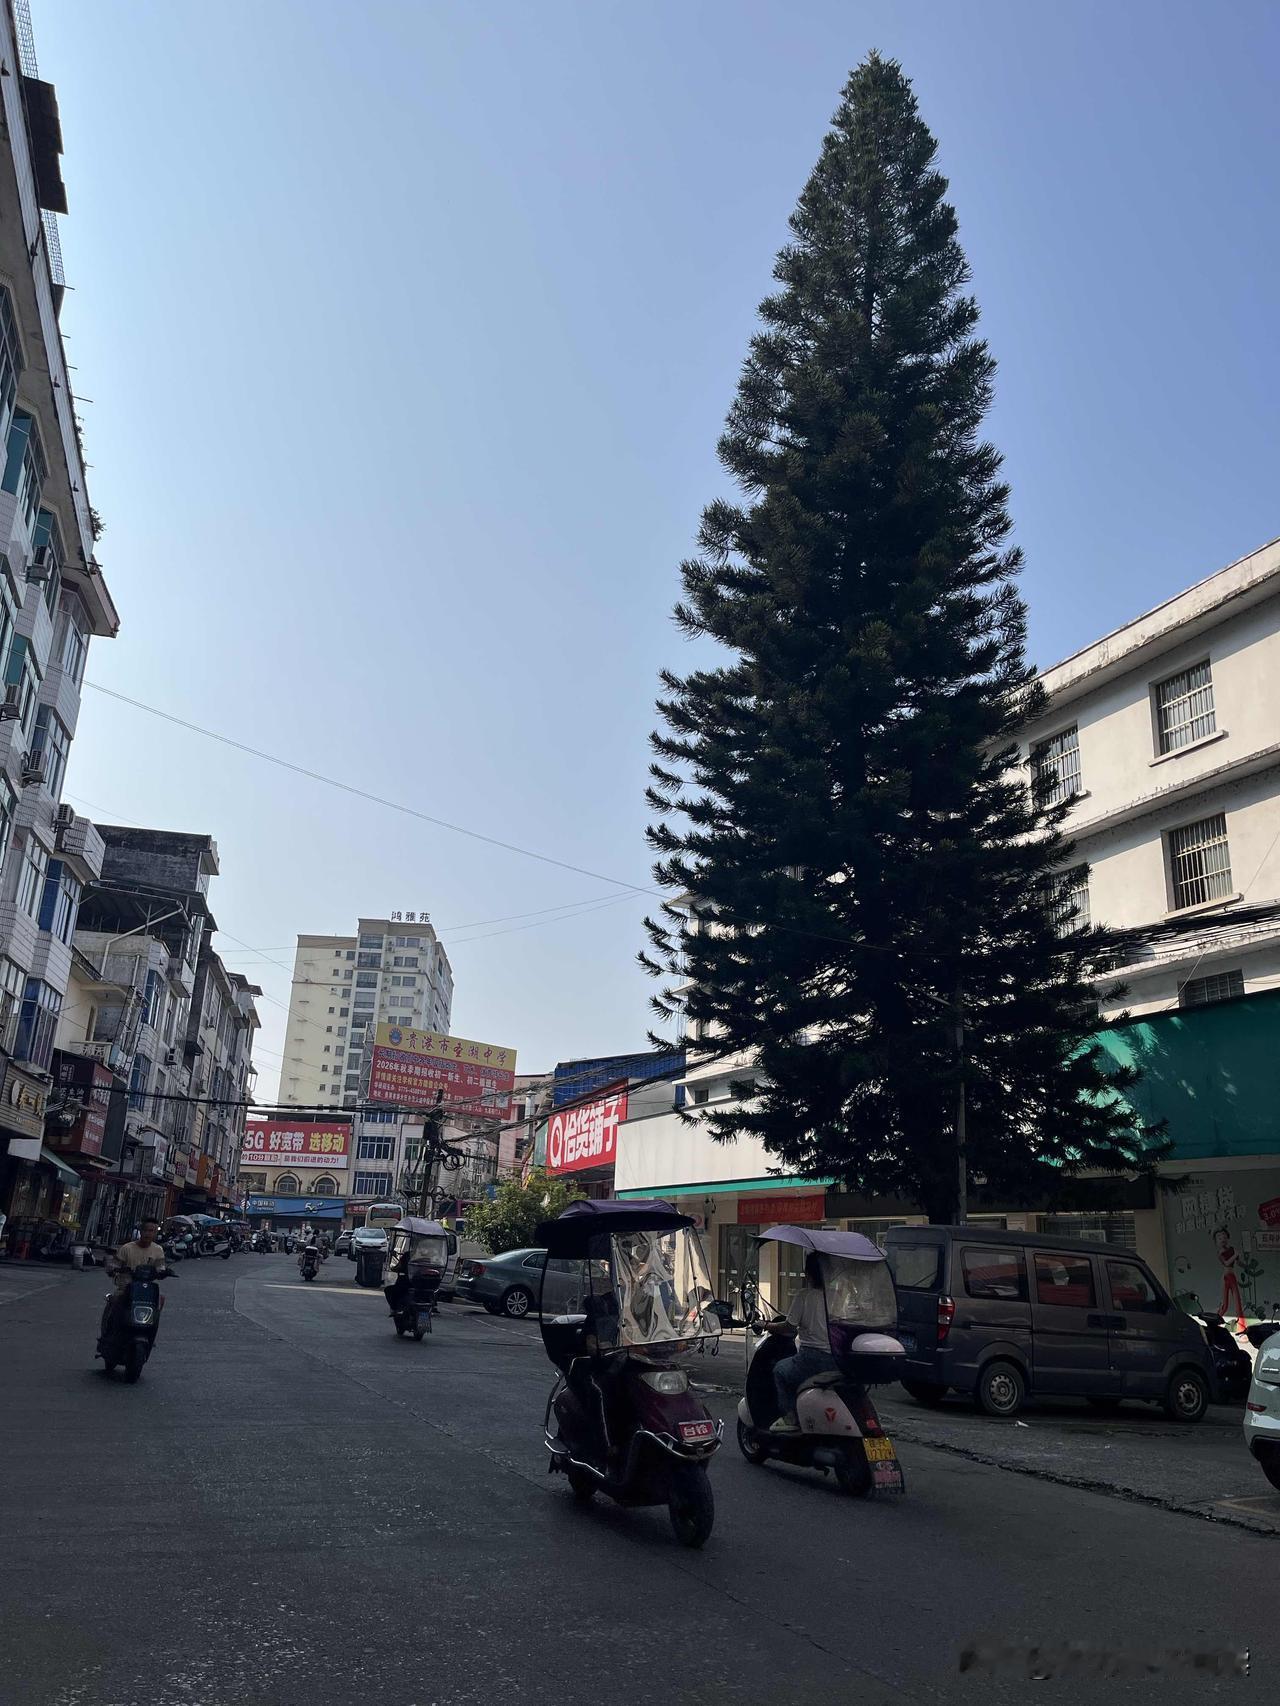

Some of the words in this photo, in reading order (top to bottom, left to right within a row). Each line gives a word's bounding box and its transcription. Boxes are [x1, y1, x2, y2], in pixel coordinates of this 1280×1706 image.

[391, 911, 430, 922] 鸿雅苑
[269, 1131, 304, 1151] 好宽带
[308, 1132, 345, 1153] 选移动
[683, 1424, 709, 1437] 台铃
